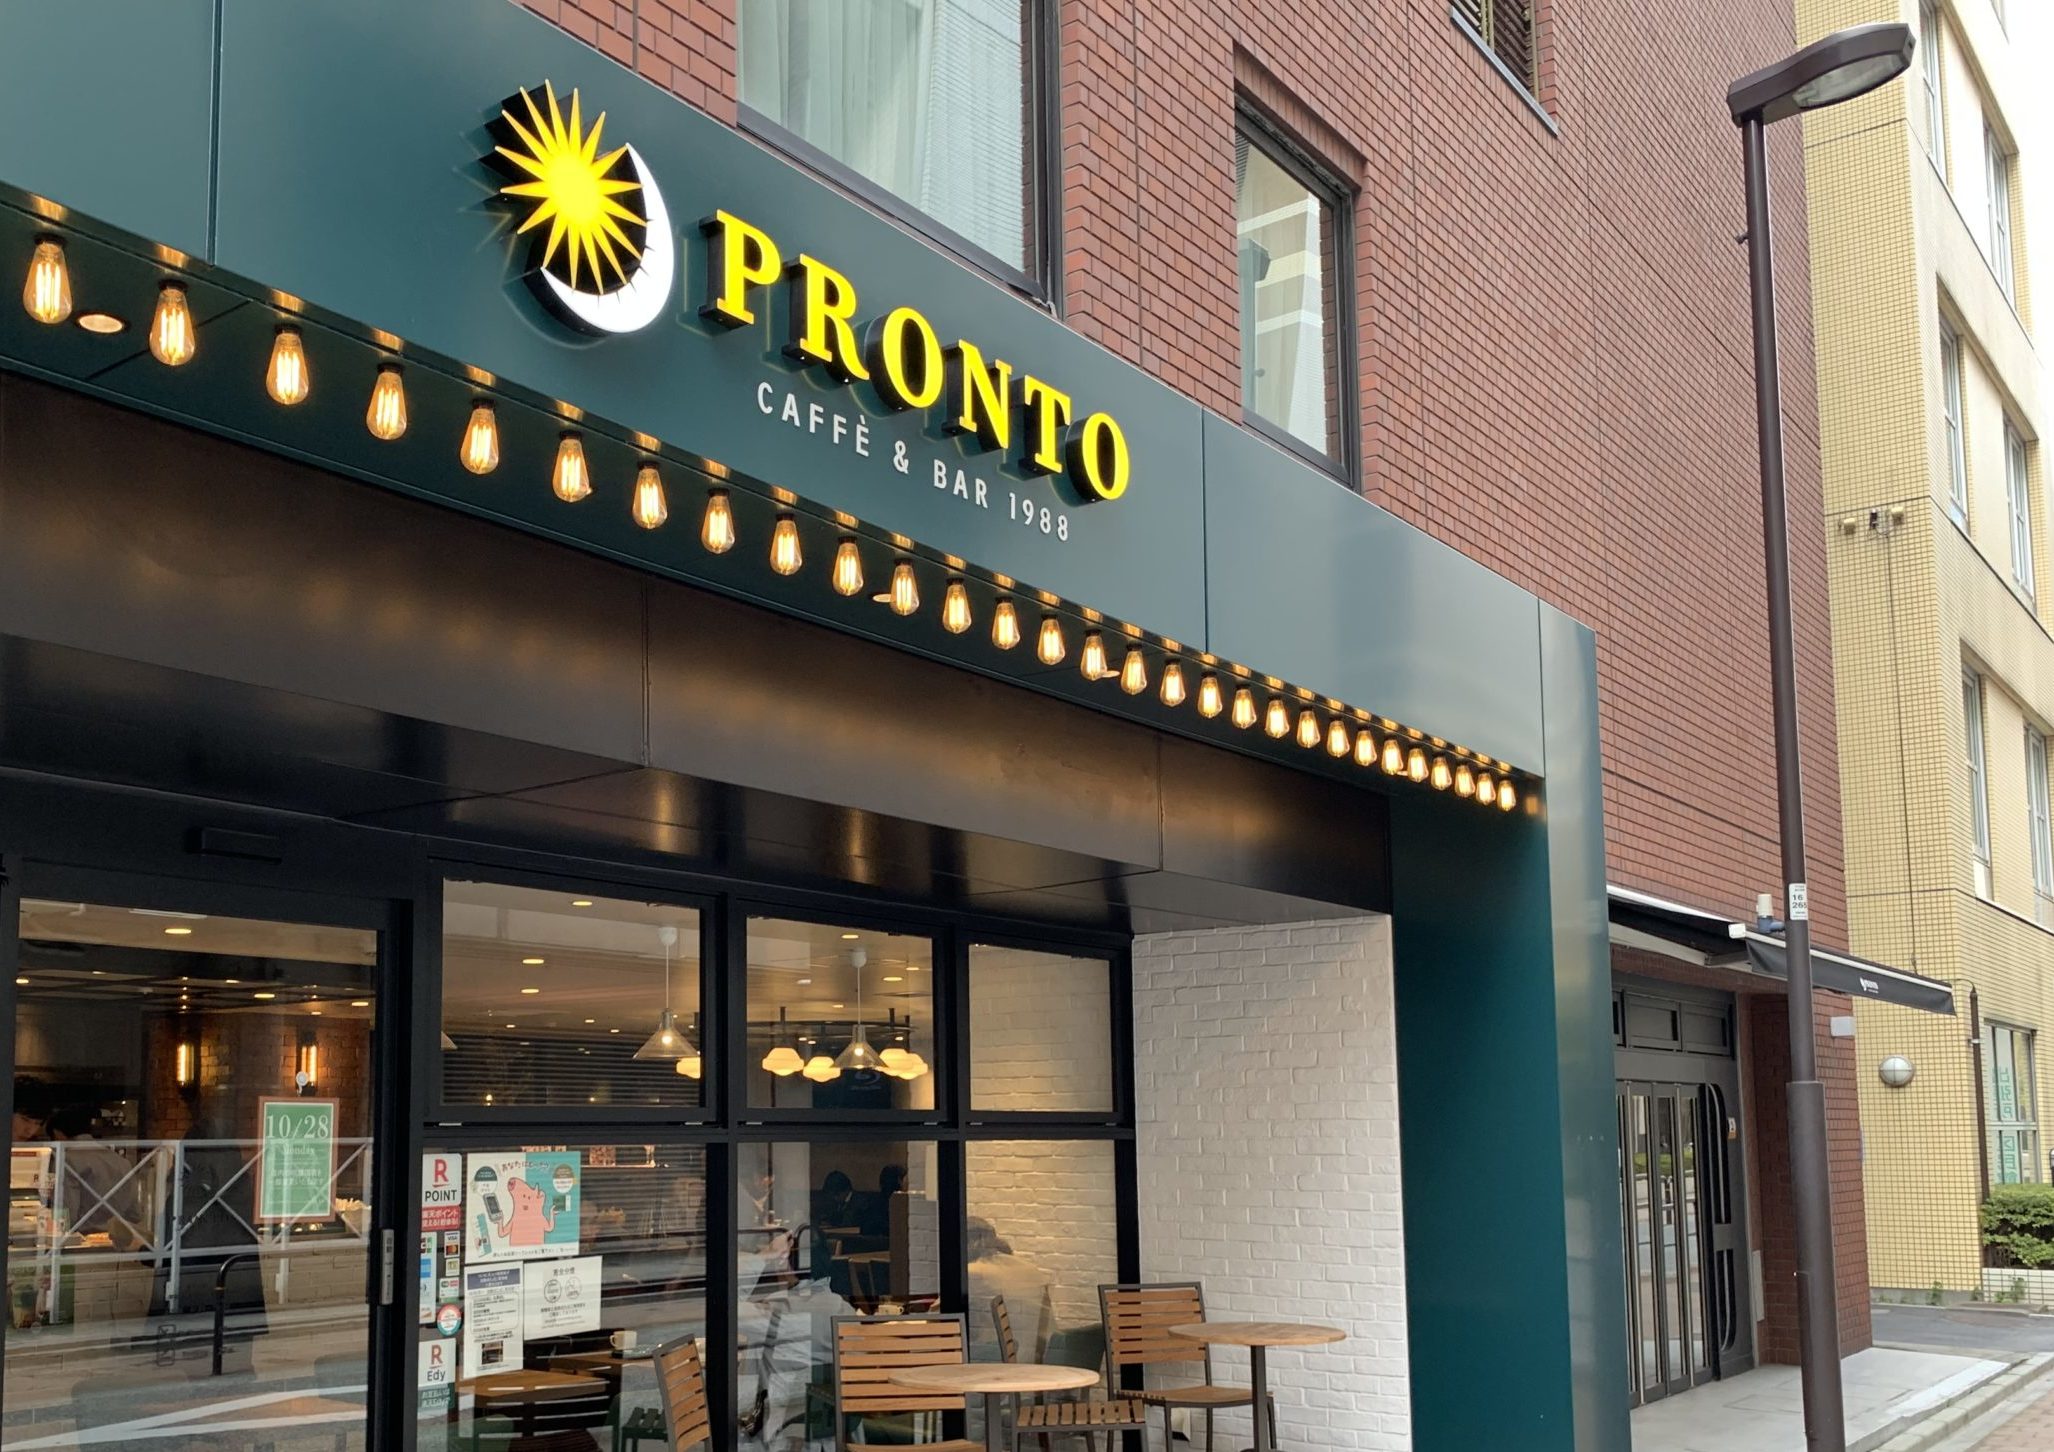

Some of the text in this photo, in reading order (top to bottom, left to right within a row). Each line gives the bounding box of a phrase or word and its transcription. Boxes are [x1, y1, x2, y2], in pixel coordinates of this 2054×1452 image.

[711, 208, 1130, 501] PRONTO
[757, 381, 1069, 542] CAFFÈ & BAR 1988
[266, 1114, 330, 1140] 10/28
[434, 1158, 449, 1183] R
[424, 1189, 458, 1202] POINT
[431, 1344, 443, 1365] R
[427, 1369, 446, 1382] Edy
